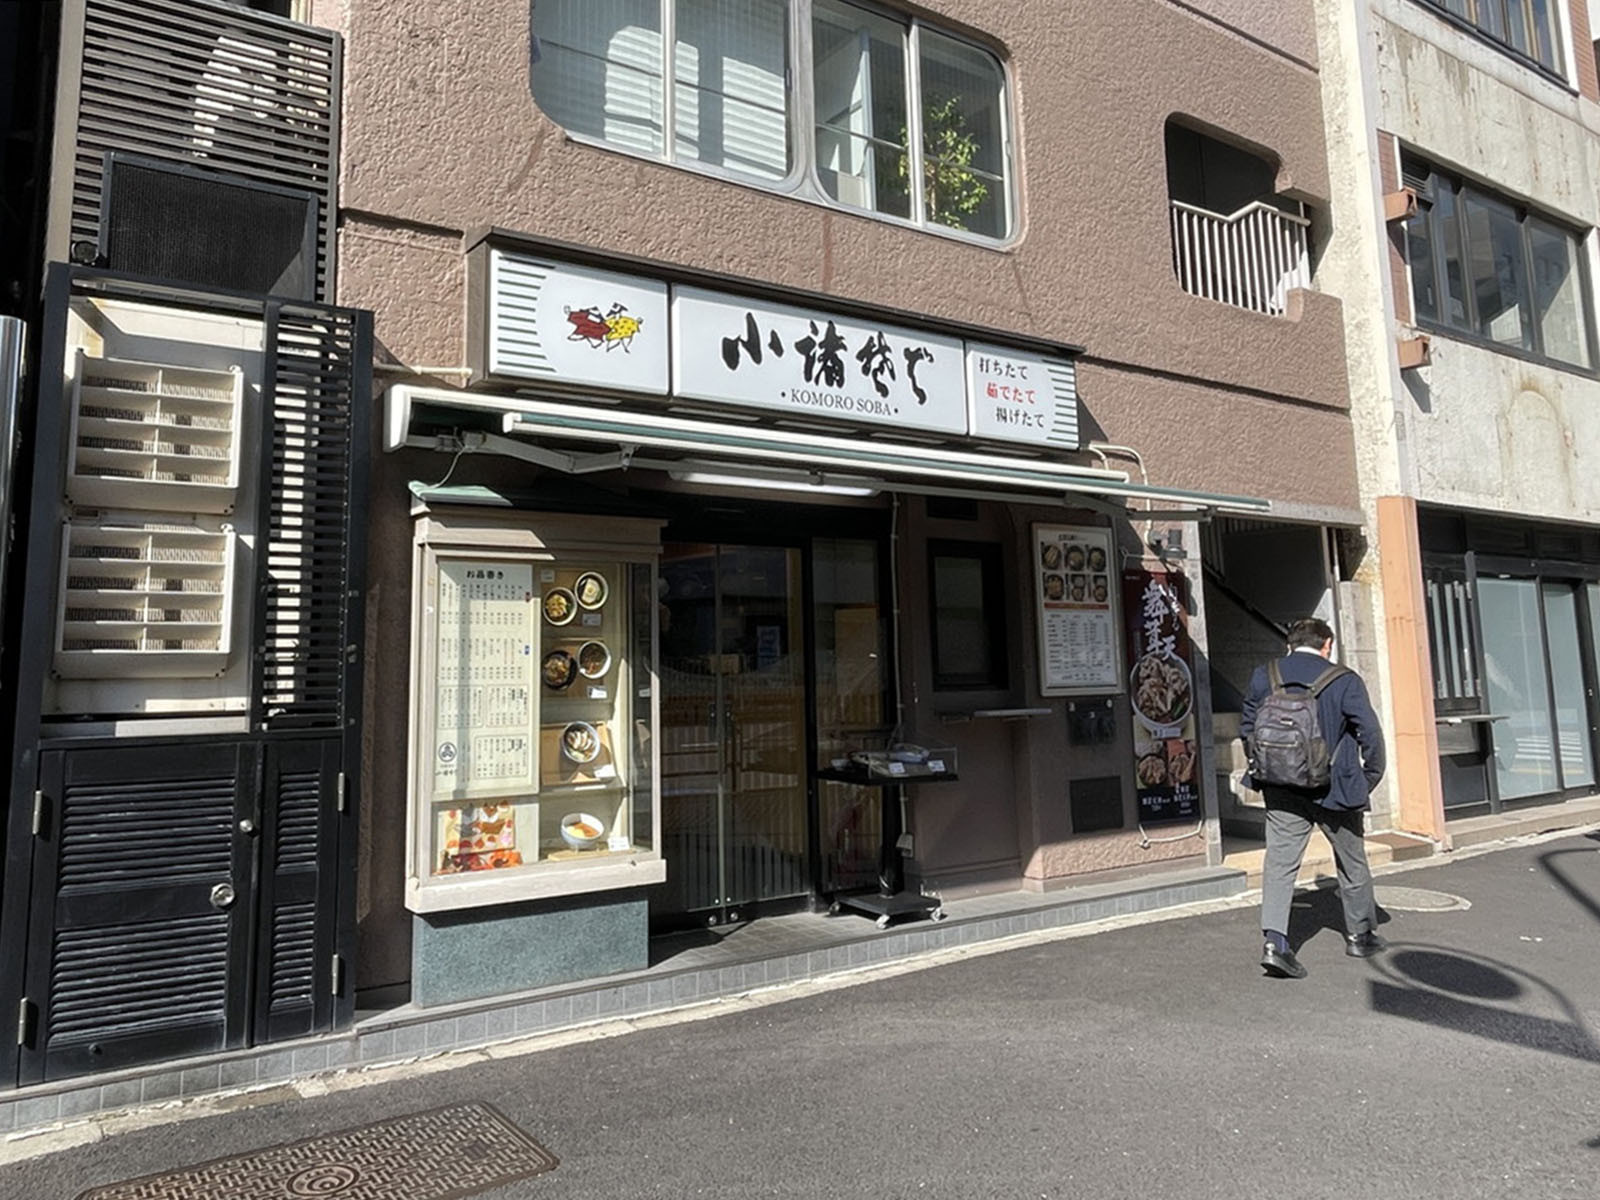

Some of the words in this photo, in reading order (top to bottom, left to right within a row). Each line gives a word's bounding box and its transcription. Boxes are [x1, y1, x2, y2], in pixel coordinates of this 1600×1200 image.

[979, 357, 1028, 380] 打ちたて
[790, 389, 854, 409] KOMORO
[857, 398, 892, 416] SOBA
[986, 381, 1035, 404] 茹でたて
[996, 406, 1045, 428] 揚げたて
